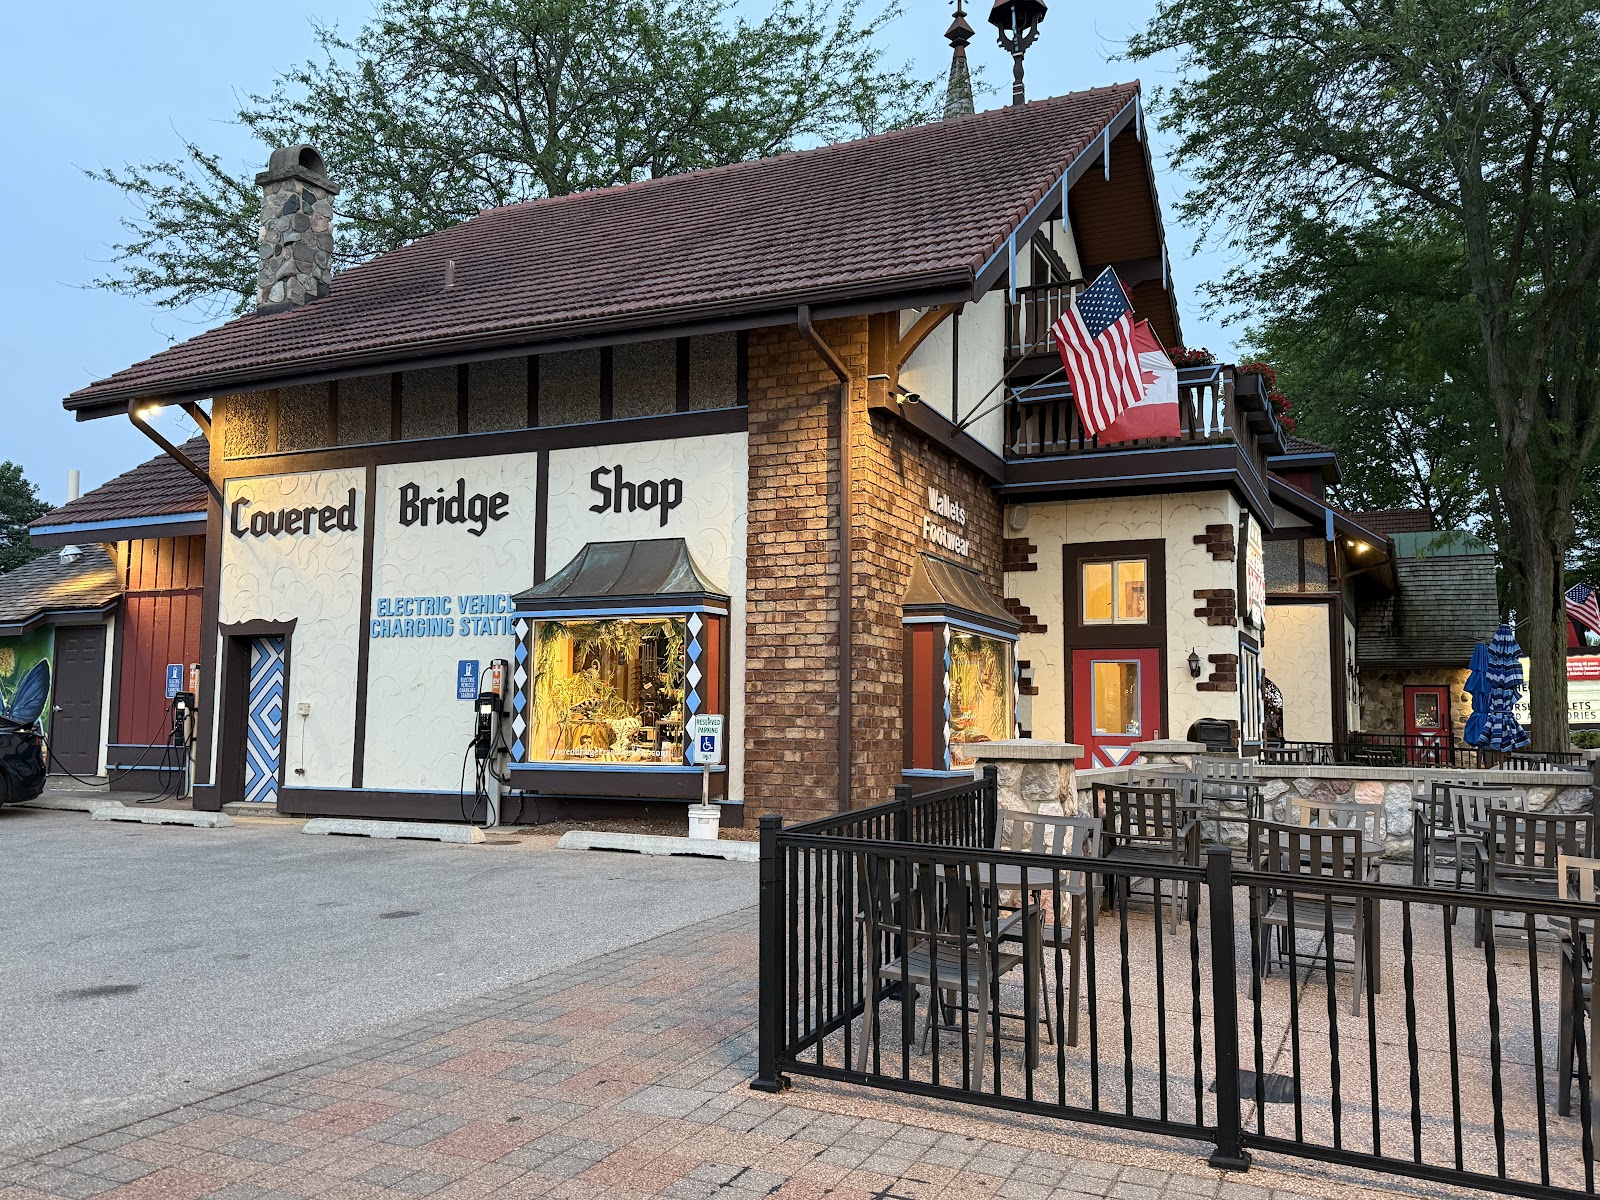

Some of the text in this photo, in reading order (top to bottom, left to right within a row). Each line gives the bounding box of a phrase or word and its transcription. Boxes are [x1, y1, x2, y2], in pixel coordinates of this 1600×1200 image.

[230, 463, 683, 539] Covered Bridge Shop
[927, 486, 966, 526] Wallets
[922, 515, 970, 557] Footwear
[377, 596, 452, 617] ELECTRIC
[370, 617, 455, 638] CHARGING
